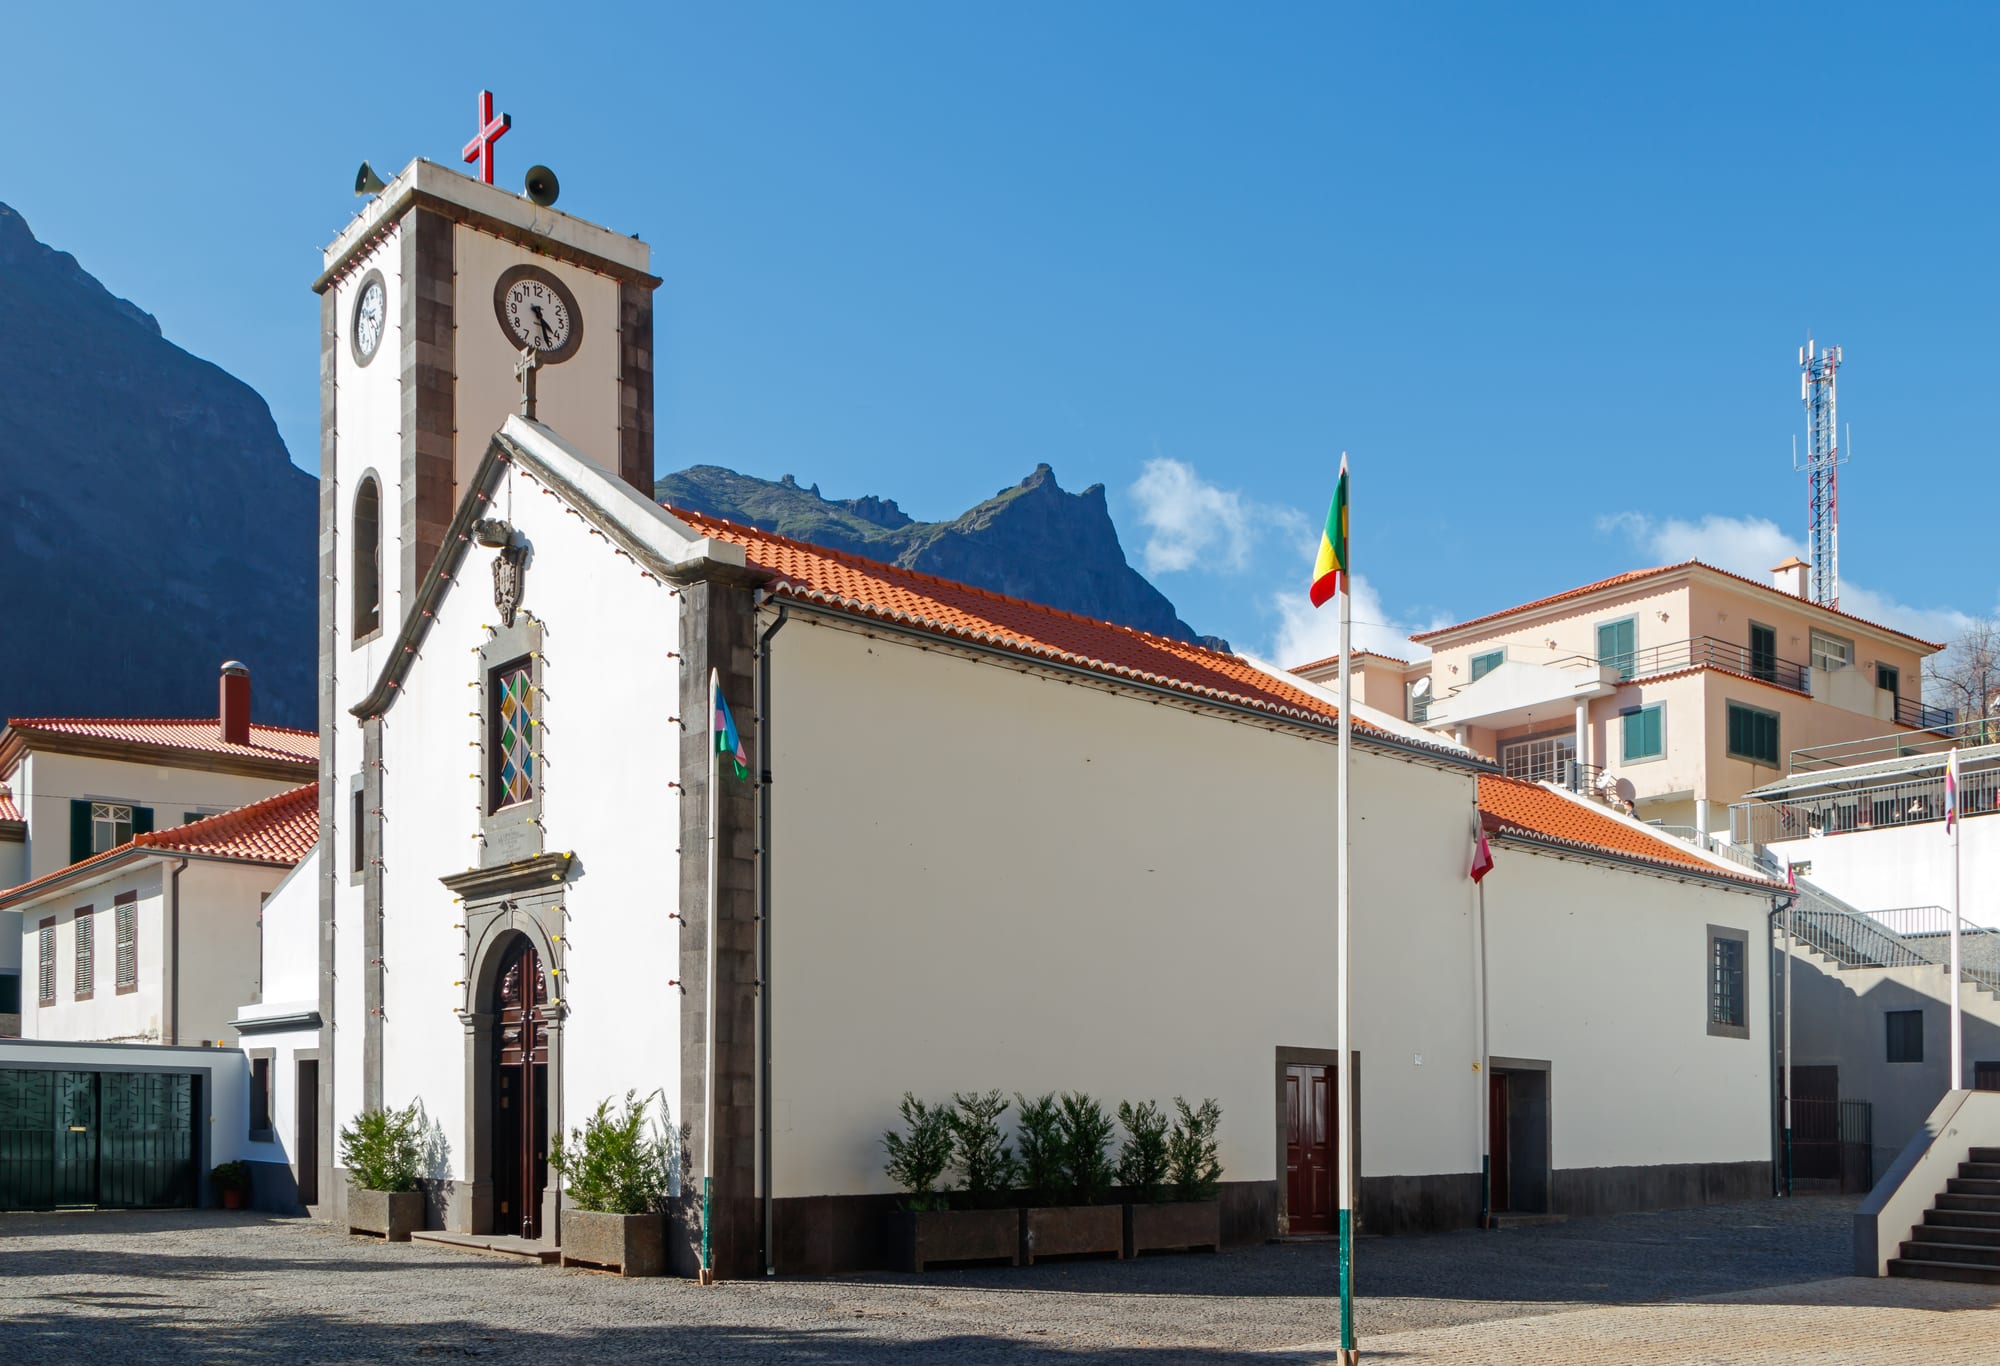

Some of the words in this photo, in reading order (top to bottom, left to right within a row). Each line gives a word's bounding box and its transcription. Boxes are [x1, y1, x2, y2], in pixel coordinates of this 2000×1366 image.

[514, 290, 522, 303] 10
[523, 285, 530, 297] 11
[533, 285, 543, 298] 12
[548, 293, 550, 304] 1
[511, 303, 517, 314] 9
[555, 305, 561, 317] 2
[514, 317, 520, 328] 8
[558, 318, 564, 329] 3
[523, 328, 529, 340] 7
[554, 330, 560, 341] 4
[535, 336, 541, 346] 6
